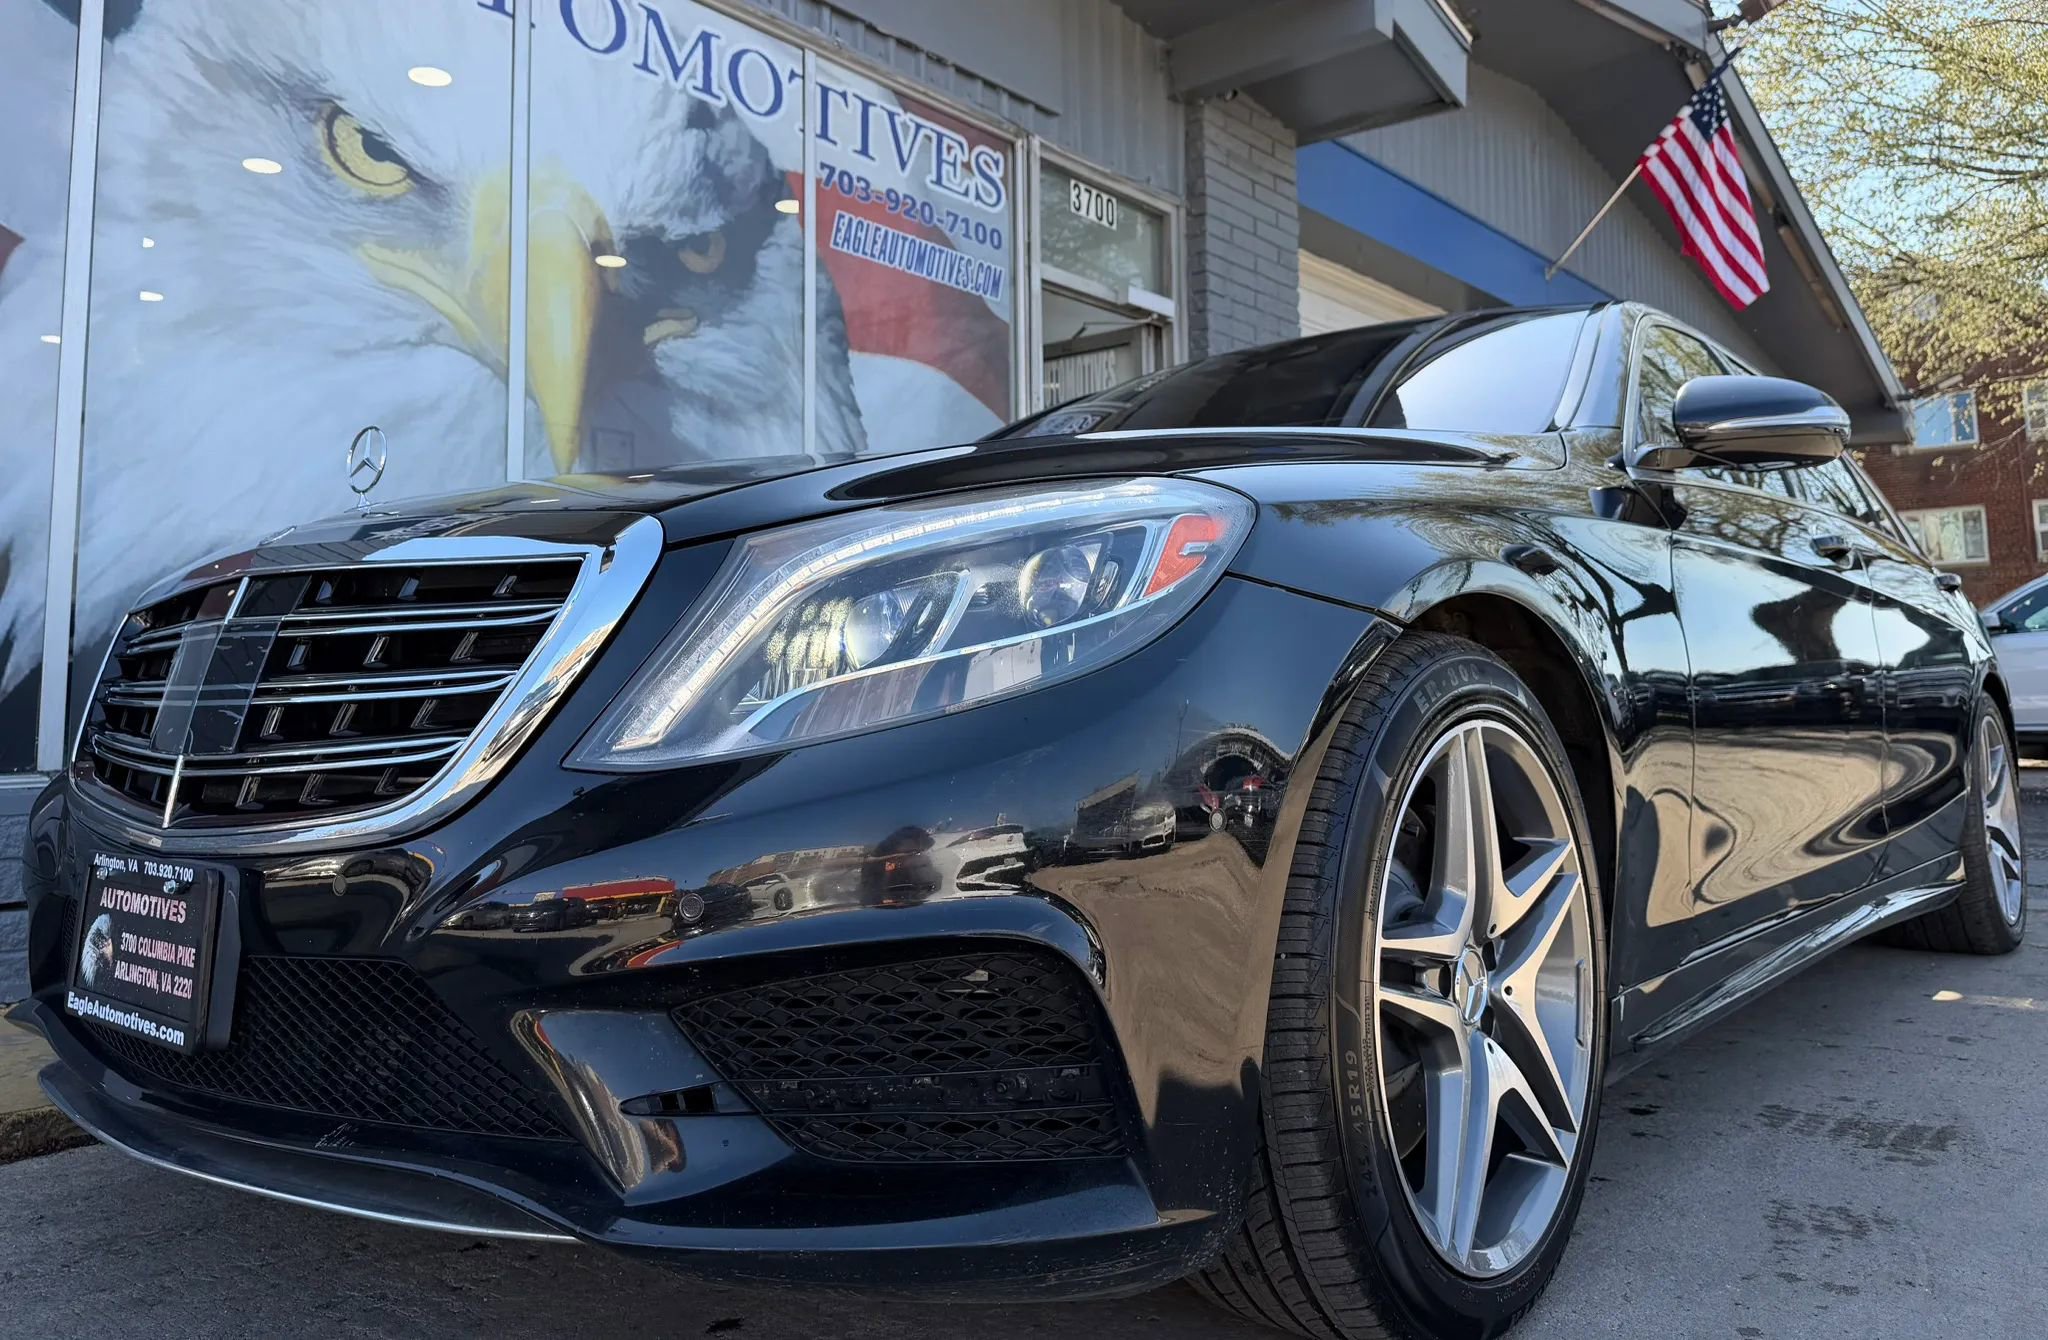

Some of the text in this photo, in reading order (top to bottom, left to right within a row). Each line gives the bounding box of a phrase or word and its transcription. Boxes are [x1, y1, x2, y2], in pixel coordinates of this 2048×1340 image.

[819, 162, 1002, 250] 703-920-7100
[1072, 183, 1115, 226] 3700
[832, 212, 1004, 299] EAGLEAUTOMOTIVES.COM
[93, 853, 194, 882] Arlington, VA 703.920.7100
[100, 887, 187, 924] AUTOMOTIVES
[120, 932, 196, 968] 3700 COLUMBIA PIKE
[114, 960, 160, 995] ARLINGTON,
[161, 971, 173, 994] VA
[67, 991, 185, 1046] EagleAutomotives.com
